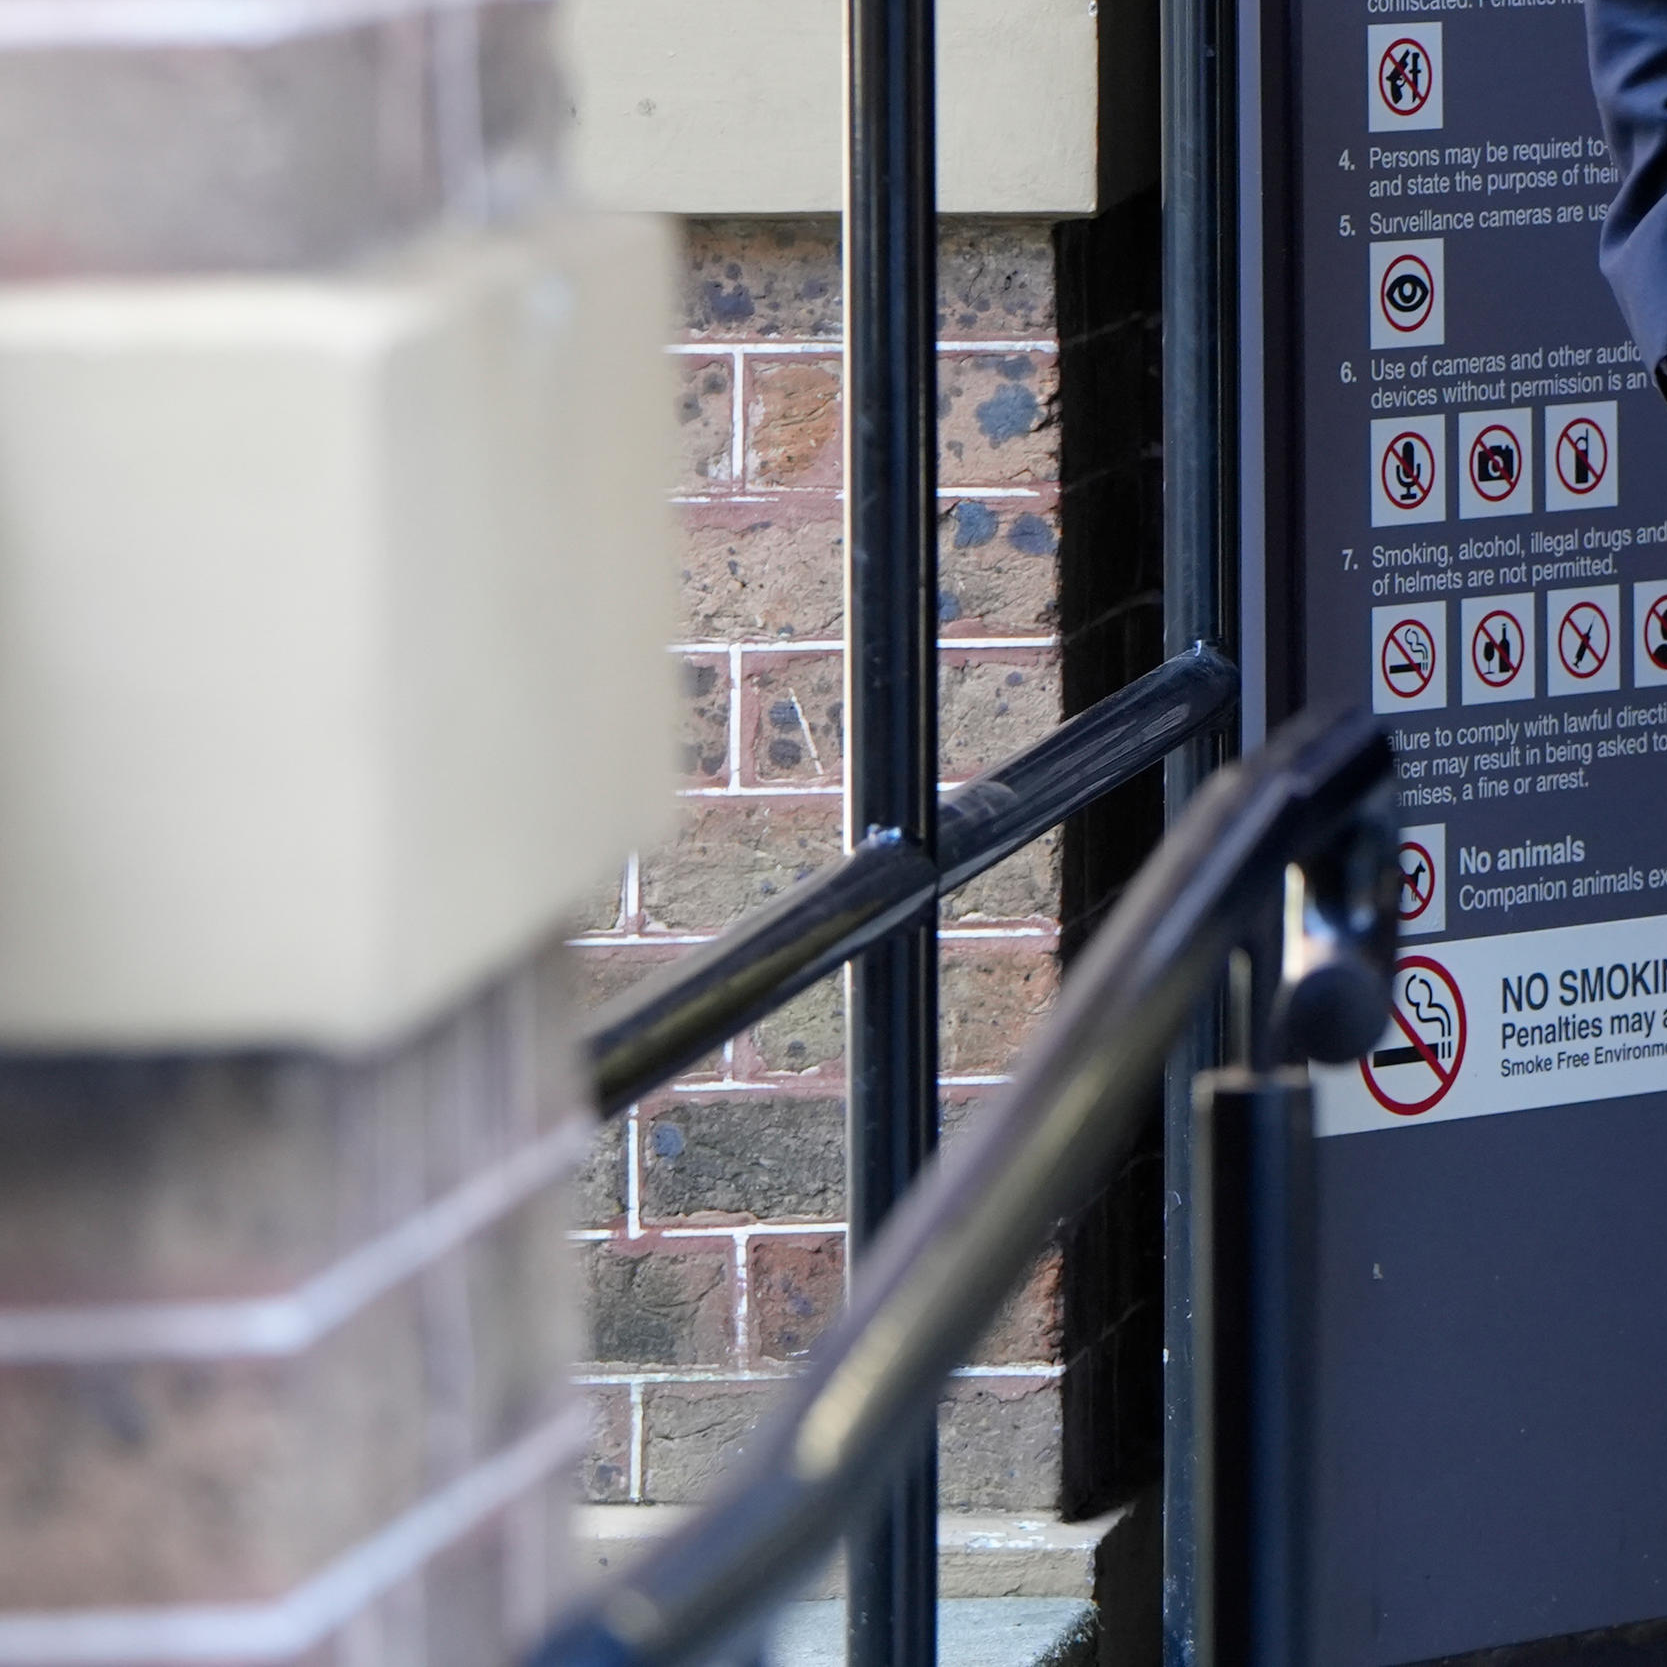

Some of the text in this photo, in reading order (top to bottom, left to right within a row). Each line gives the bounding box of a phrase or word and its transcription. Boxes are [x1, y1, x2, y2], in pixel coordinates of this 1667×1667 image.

[1338, 150, 1355, 171] 4.
[1369, 147, 1439, 169] Persons
[1445, 147, 1481, 168] may
[1487, 141, 1508, 163] be
[1513, 136, 1582, 164] required
[1369, 175, 1402, 198] and
[1407, 173, 1449, 195] state
[1455, 171, 1481, 192] the
[1487, 168, 1557, 195] purpose
[1562, 164, 1579, 185] of
[1340, 201, 1609, 236] 5. Surveillance cameras are us
[1341, 362, 1356, 383] 6.
[1371, 358, 1405, 381] Use
[1411, 355, 1428, 377] of
[1433, 352, 1505, 376] cameras
[1511, 348, 1542, 370] and
[1548, 345, 1591, 367] other
[1371, 370, 1647, 409] devices without permission is an
[1342, 549, 1358, 571] 7.
[1372, 542, 1453, 569] Smoking,
[1459, 533, 1525, 560] alcohol,
[1530, 525, 1578, 554] illegal
[1584, 523, 1631, 550] drugs
[1637, 521, 1667, 543] and
[1372, 553, 1617, 597] of helmets are not permitted.
[1387, 730, 1430, 753] ailure
[1435, 726, 1452, 745] to
[1457, 719, 1518, 747] comply
[1524, 714, 1558, 737] with
[1564, 708, 1612, 733] lawful
[1433, 754, 1468, 778] may
[1474, 746, 1521, 771] result
[1526, 742, 1541, 766] in
[1545, 736, 1592, 765] being
[1597, 730, 1647, 758] asked
[1462, 784, 1474, 800] a
[1478, 773, 1509, 798] fine
[1513, 776, 1530, 795] or
[1536, 767, 1589, 793] arrest.
[1459, 835, 1585, 875] No animals
[1459, 879, 1568, 912] Companion
[1572, 866, 1644, 897] animals
[1502, 973, 1548, 1015] NO
[1502, 1014, 1602, 1050] Penalties
[1610, 1008, 1656, 1039] may
[1501, 1052, 1553, 1078] Smoke
[1557, 1042, 1590, 1070] Free
